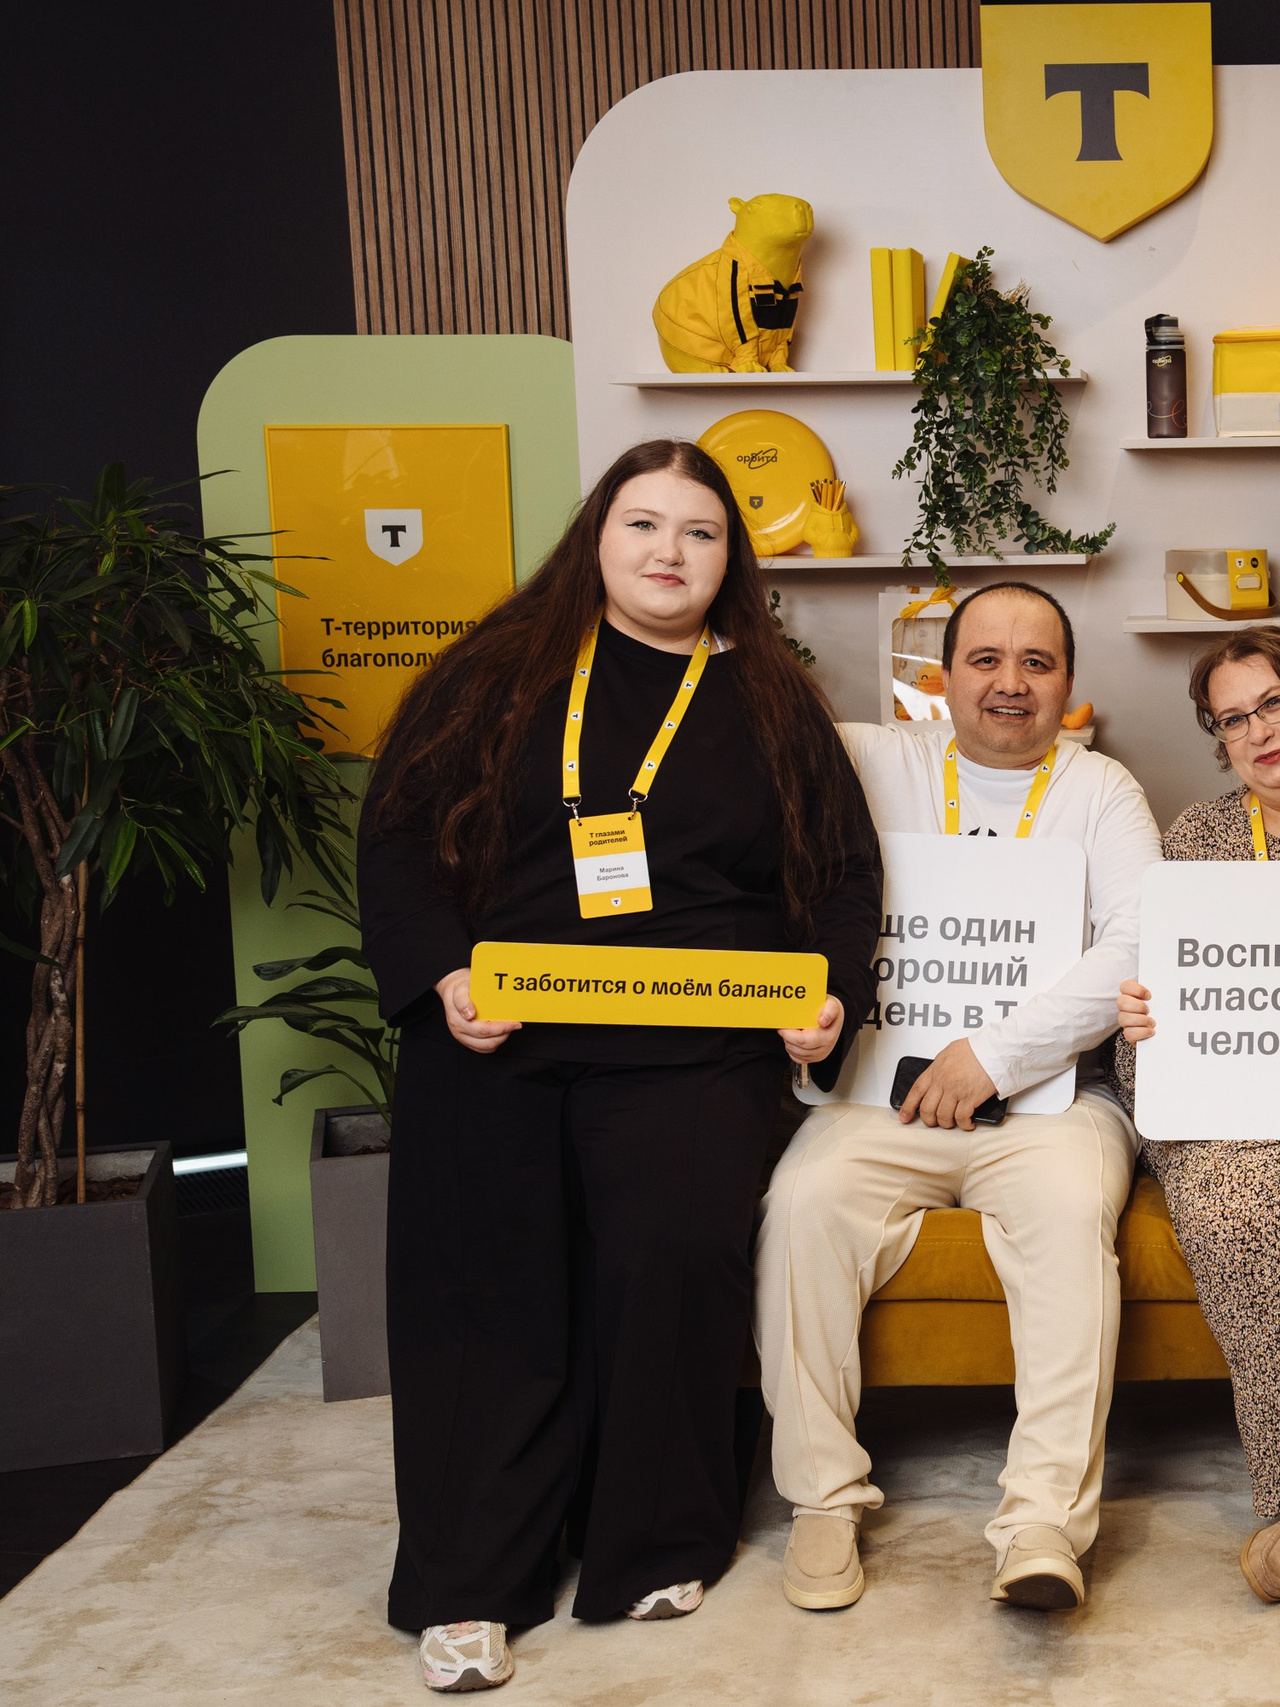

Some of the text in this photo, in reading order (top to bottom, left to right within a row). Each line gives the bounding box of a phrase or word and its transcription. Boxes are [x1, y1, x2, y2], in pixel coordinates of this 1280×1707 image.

[1044, 63, 1149, 161] Т
[382, 525, 406, 547] Т
[321, 618, 478, 640] Т-территория
[589, 836, 628, 847] родителей
[595, 829, 626, 838] глазами
[599, 866, 624, 874] Марина
[879, 914, 1036, 947] ще один
[873, 956, 1028, 990] ороший
[494, 973, 806, 1000] Т заботится о моём балансе
[964, 1006, 983, 1028] в
